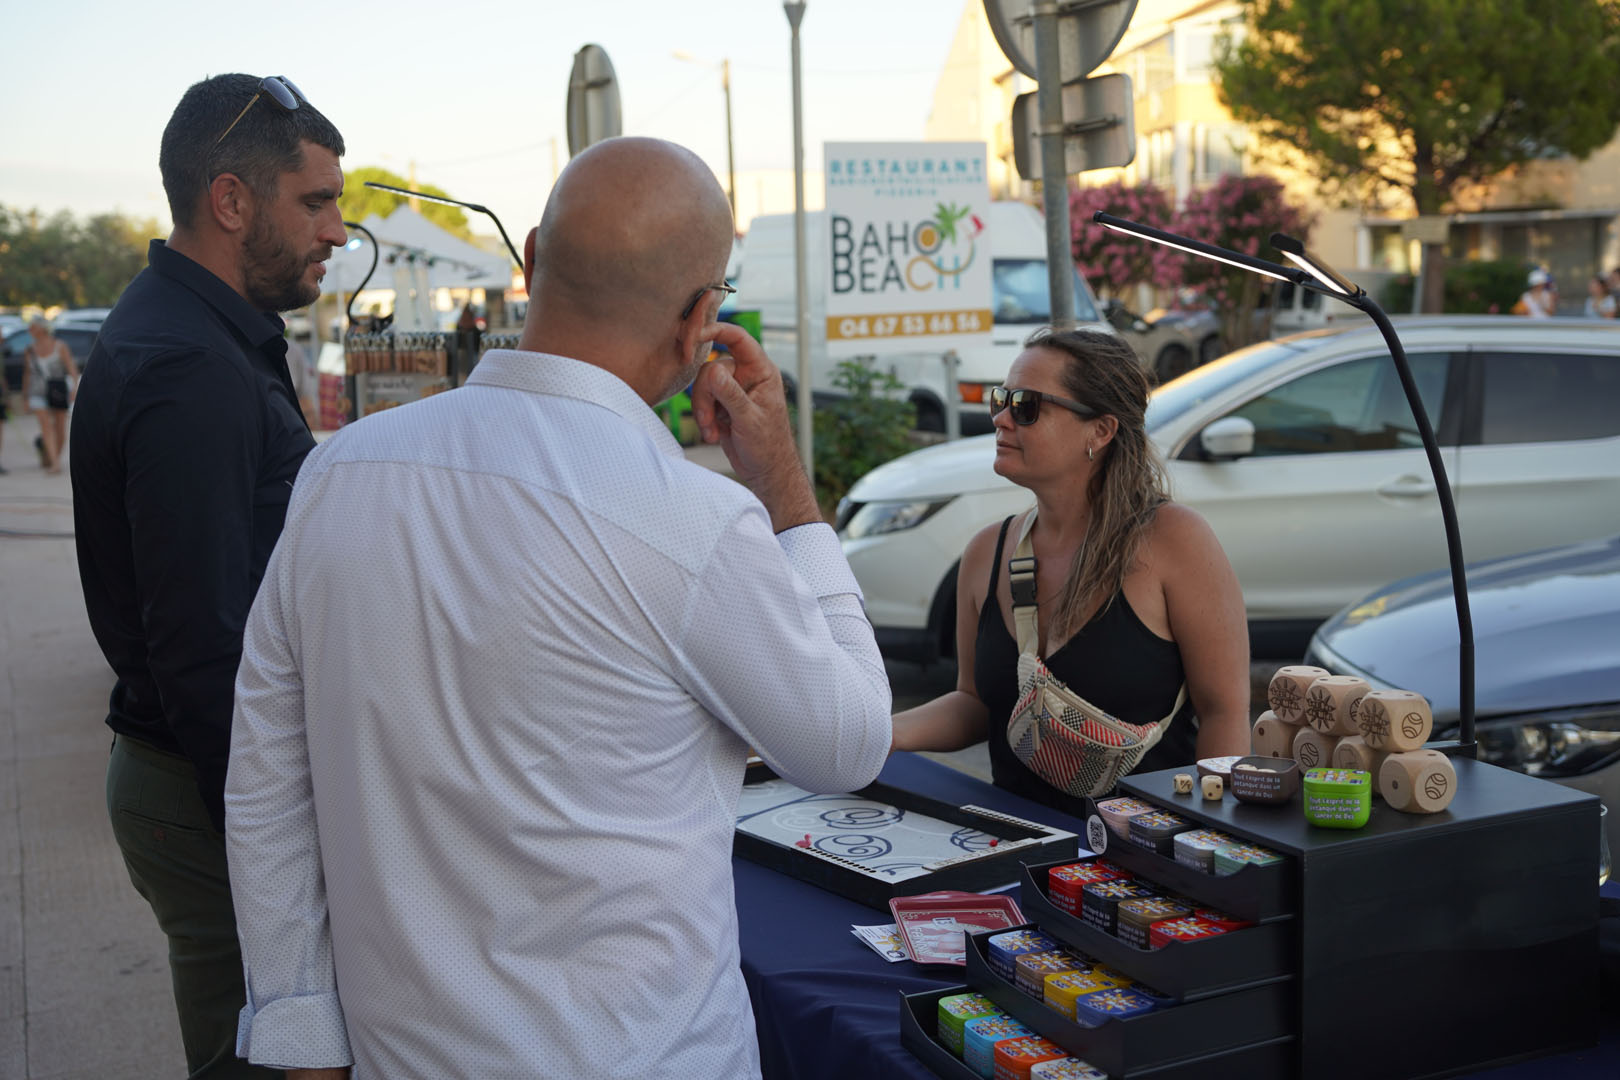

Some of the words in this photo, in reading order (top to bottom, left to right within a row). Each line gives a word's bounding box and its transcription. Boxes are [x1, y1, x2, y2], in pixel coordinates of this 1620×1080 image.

[830, 158, 981, 174] RESTAURANT
[831, 215, 944, 257] BAHO
[832, 254, 961, 294] BEACH
[840, 318, 869, 337] 04
[873, 316, 898, 335] 67
